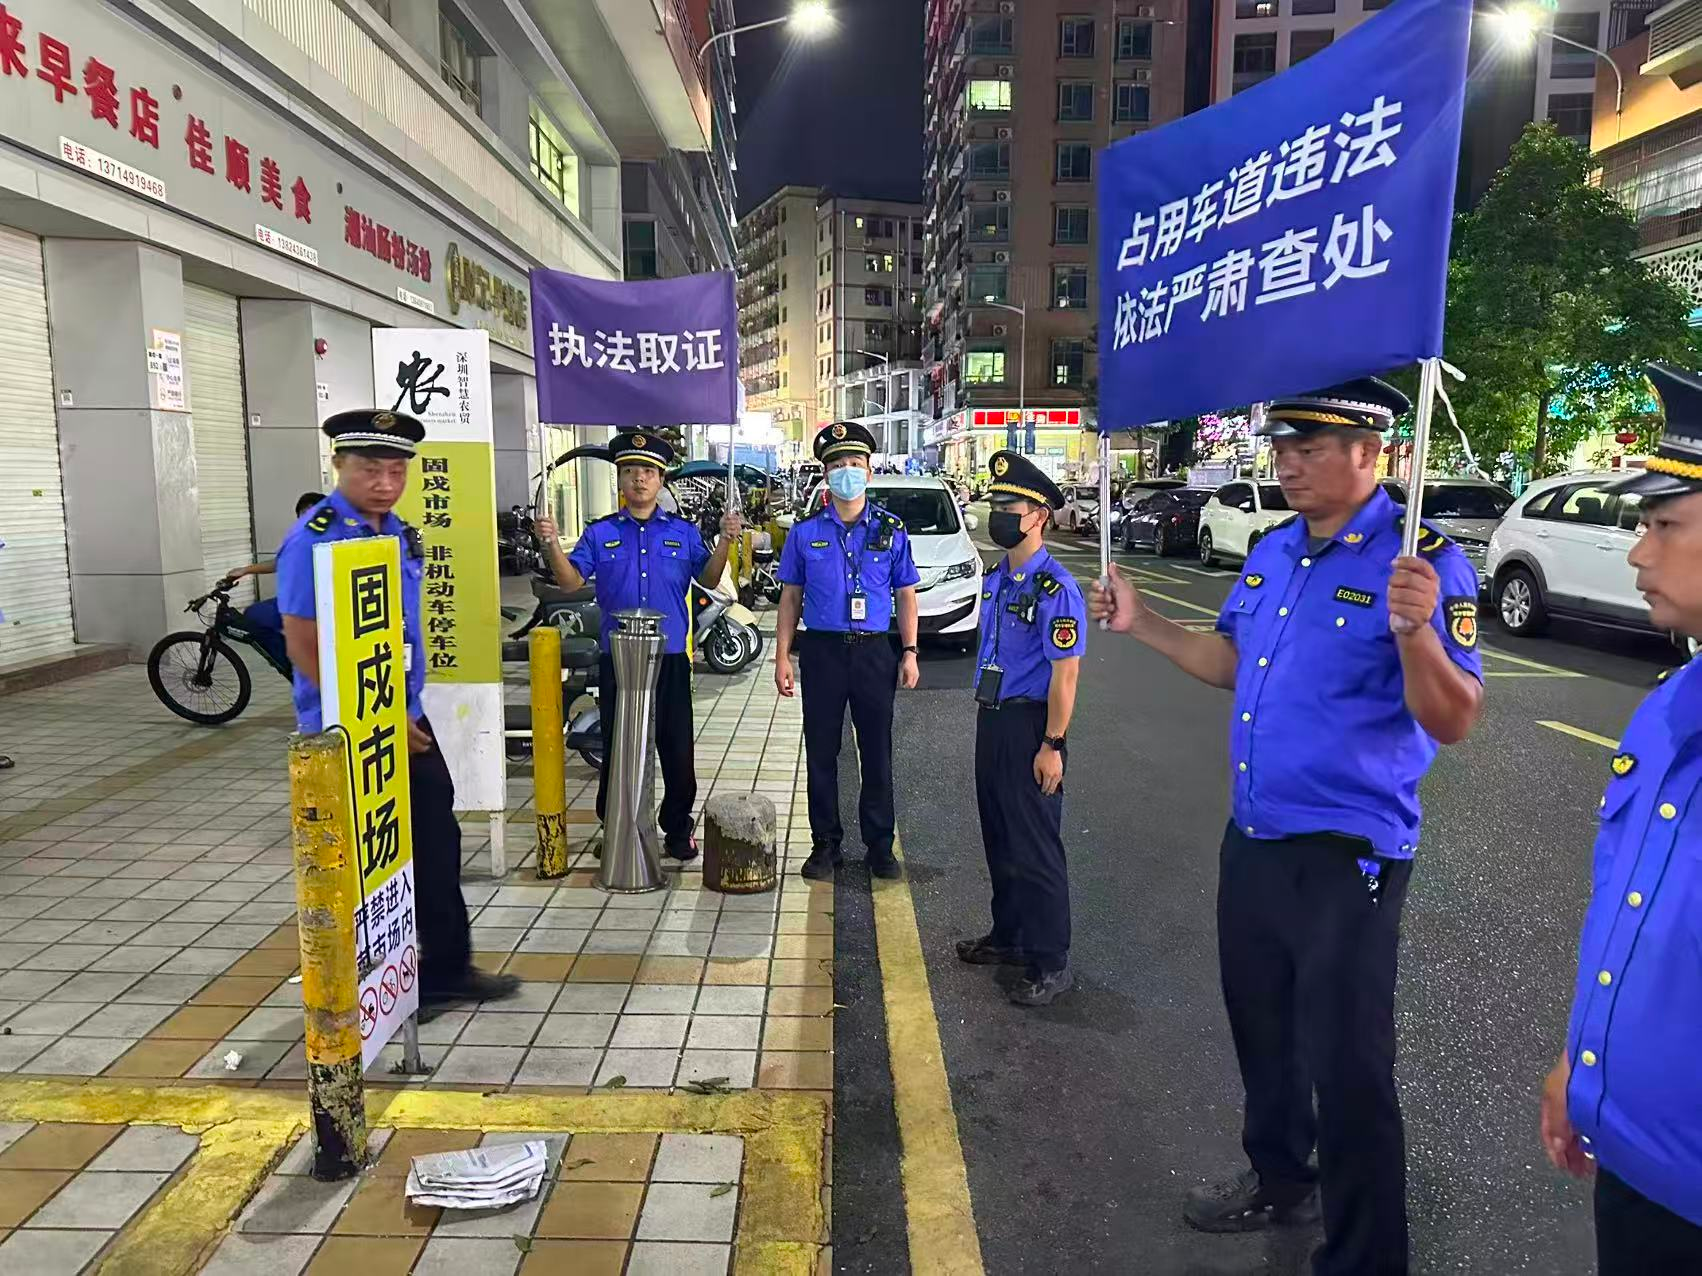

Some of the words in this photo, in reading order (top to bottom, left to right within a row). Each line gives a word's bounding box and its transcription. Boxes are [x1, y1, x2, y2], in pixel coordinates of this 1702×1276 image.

[184, 113, 312, 225] 佳顺美食
[1116, 95, 1402, 272] 占用车道违法
[1113, 203, 1393, 351] 依法严肃查处
[456, 351, 470, 425] 深圳智慧农贸
[548, 322, 725, 375] 执法取证
[421, 456, 453, 529] 固戍市场
[425, 545, 459, 669] 非机动车停车位
[1337, 588, 1371, 605] E02031
[351, 563, 400, 880] 固戍市场
[353, 870, 412, 945] 严禁进入
